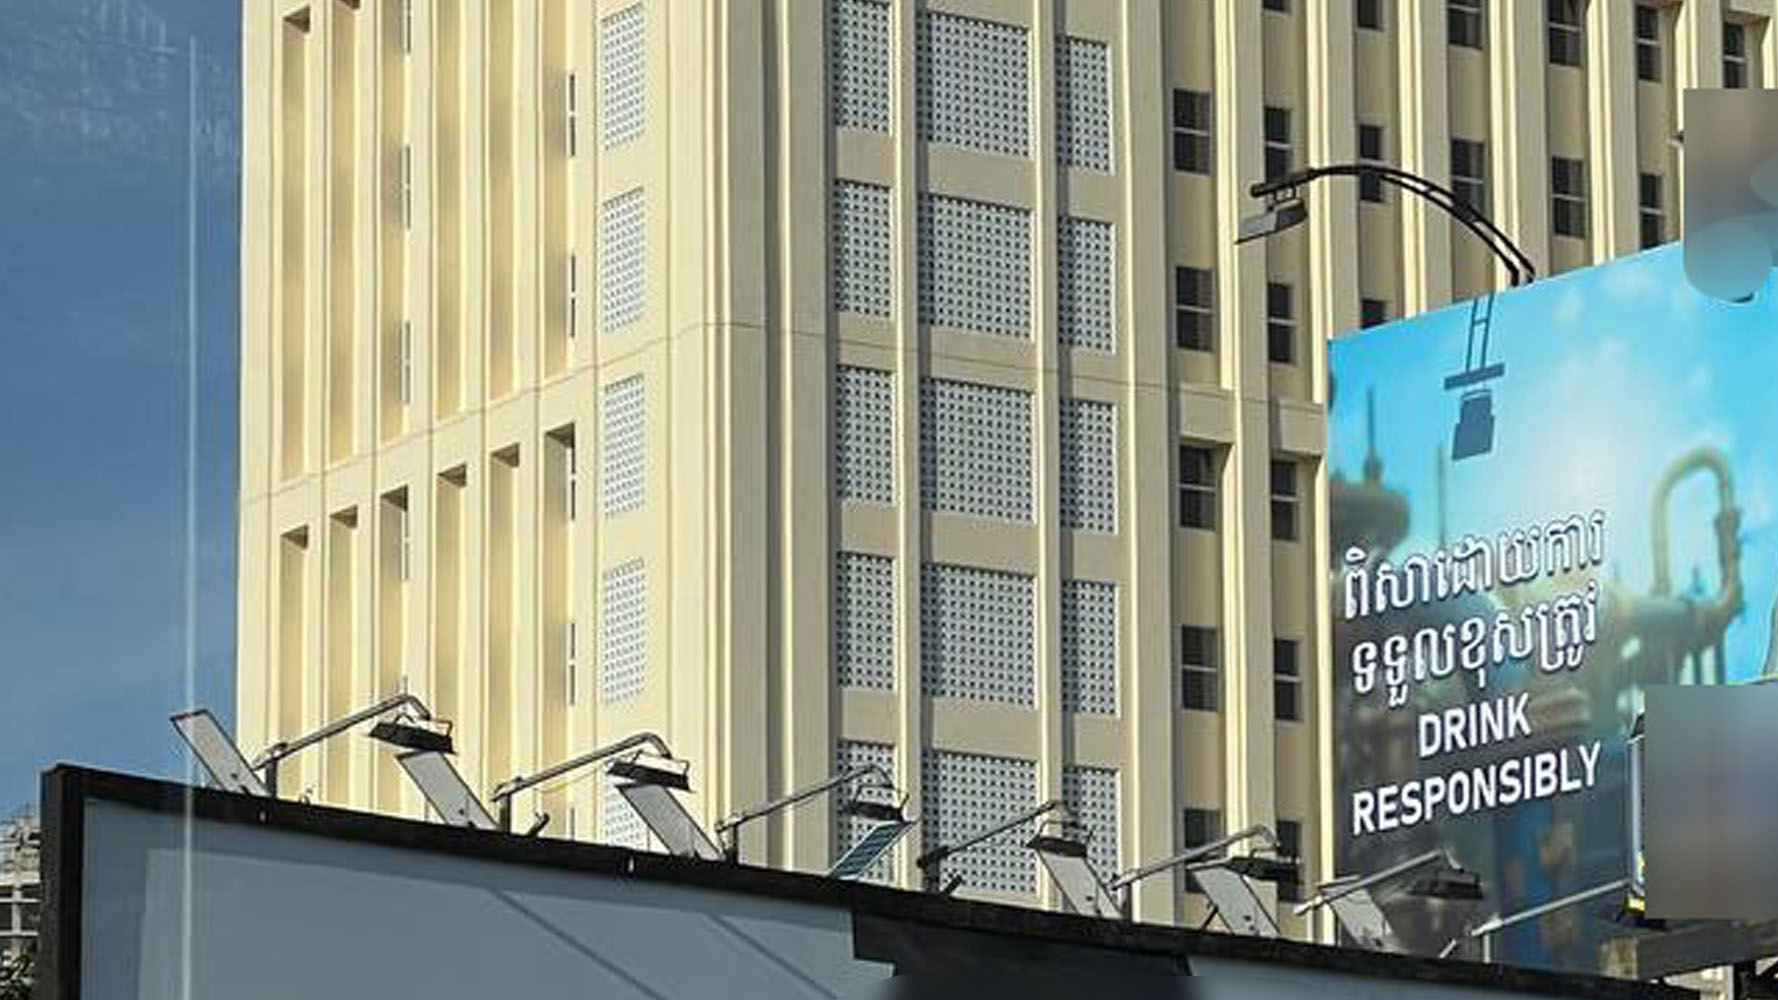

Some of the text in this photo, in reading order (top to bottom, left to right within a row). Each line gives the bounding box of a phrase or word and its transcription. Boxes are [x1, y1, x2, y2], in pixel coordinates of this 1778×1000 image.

[1344, 510, 1607, 620] ពិសាដោយការ
[1352, 581, 1601, 707] ទទួលខុសត្រូវ
[1419, 692, 1532, 758] DRINK
[1352, 742, 1601, 835] RESPONSIBLY
